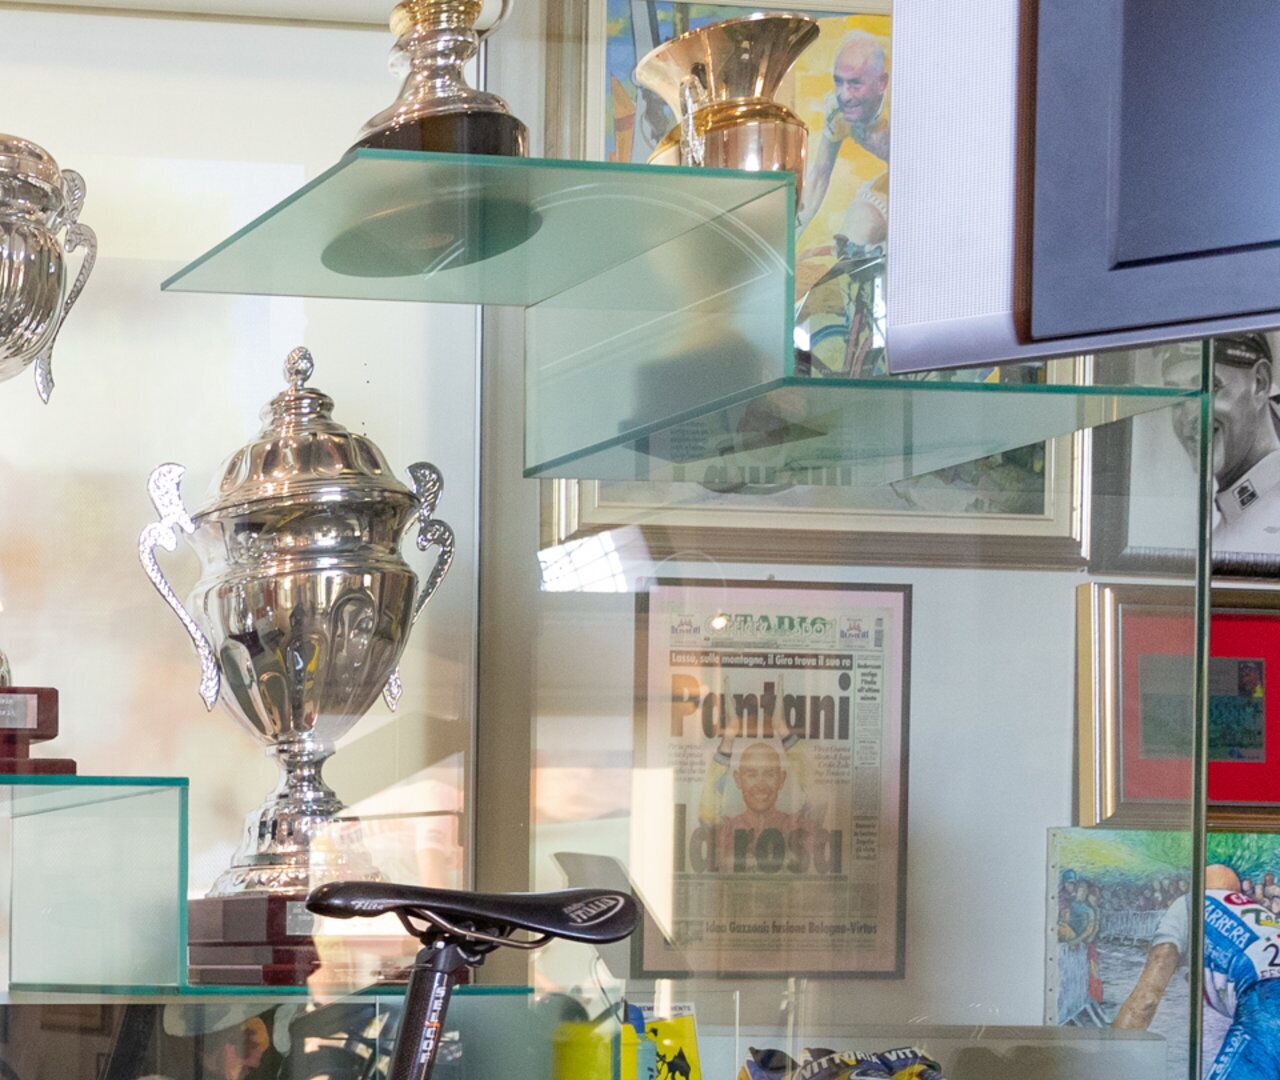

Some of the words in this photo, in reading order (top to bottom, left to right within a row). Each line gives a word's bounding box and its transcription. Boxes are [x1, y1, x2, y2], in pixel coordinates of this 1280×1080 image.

[775, 655, 794, 667] Giro
[795, 656, 817, 667] trova
[842, 660, 852, 668] re
[671, 671, 852, 740] Pantani
[733, 827, 844, 874] rosa
